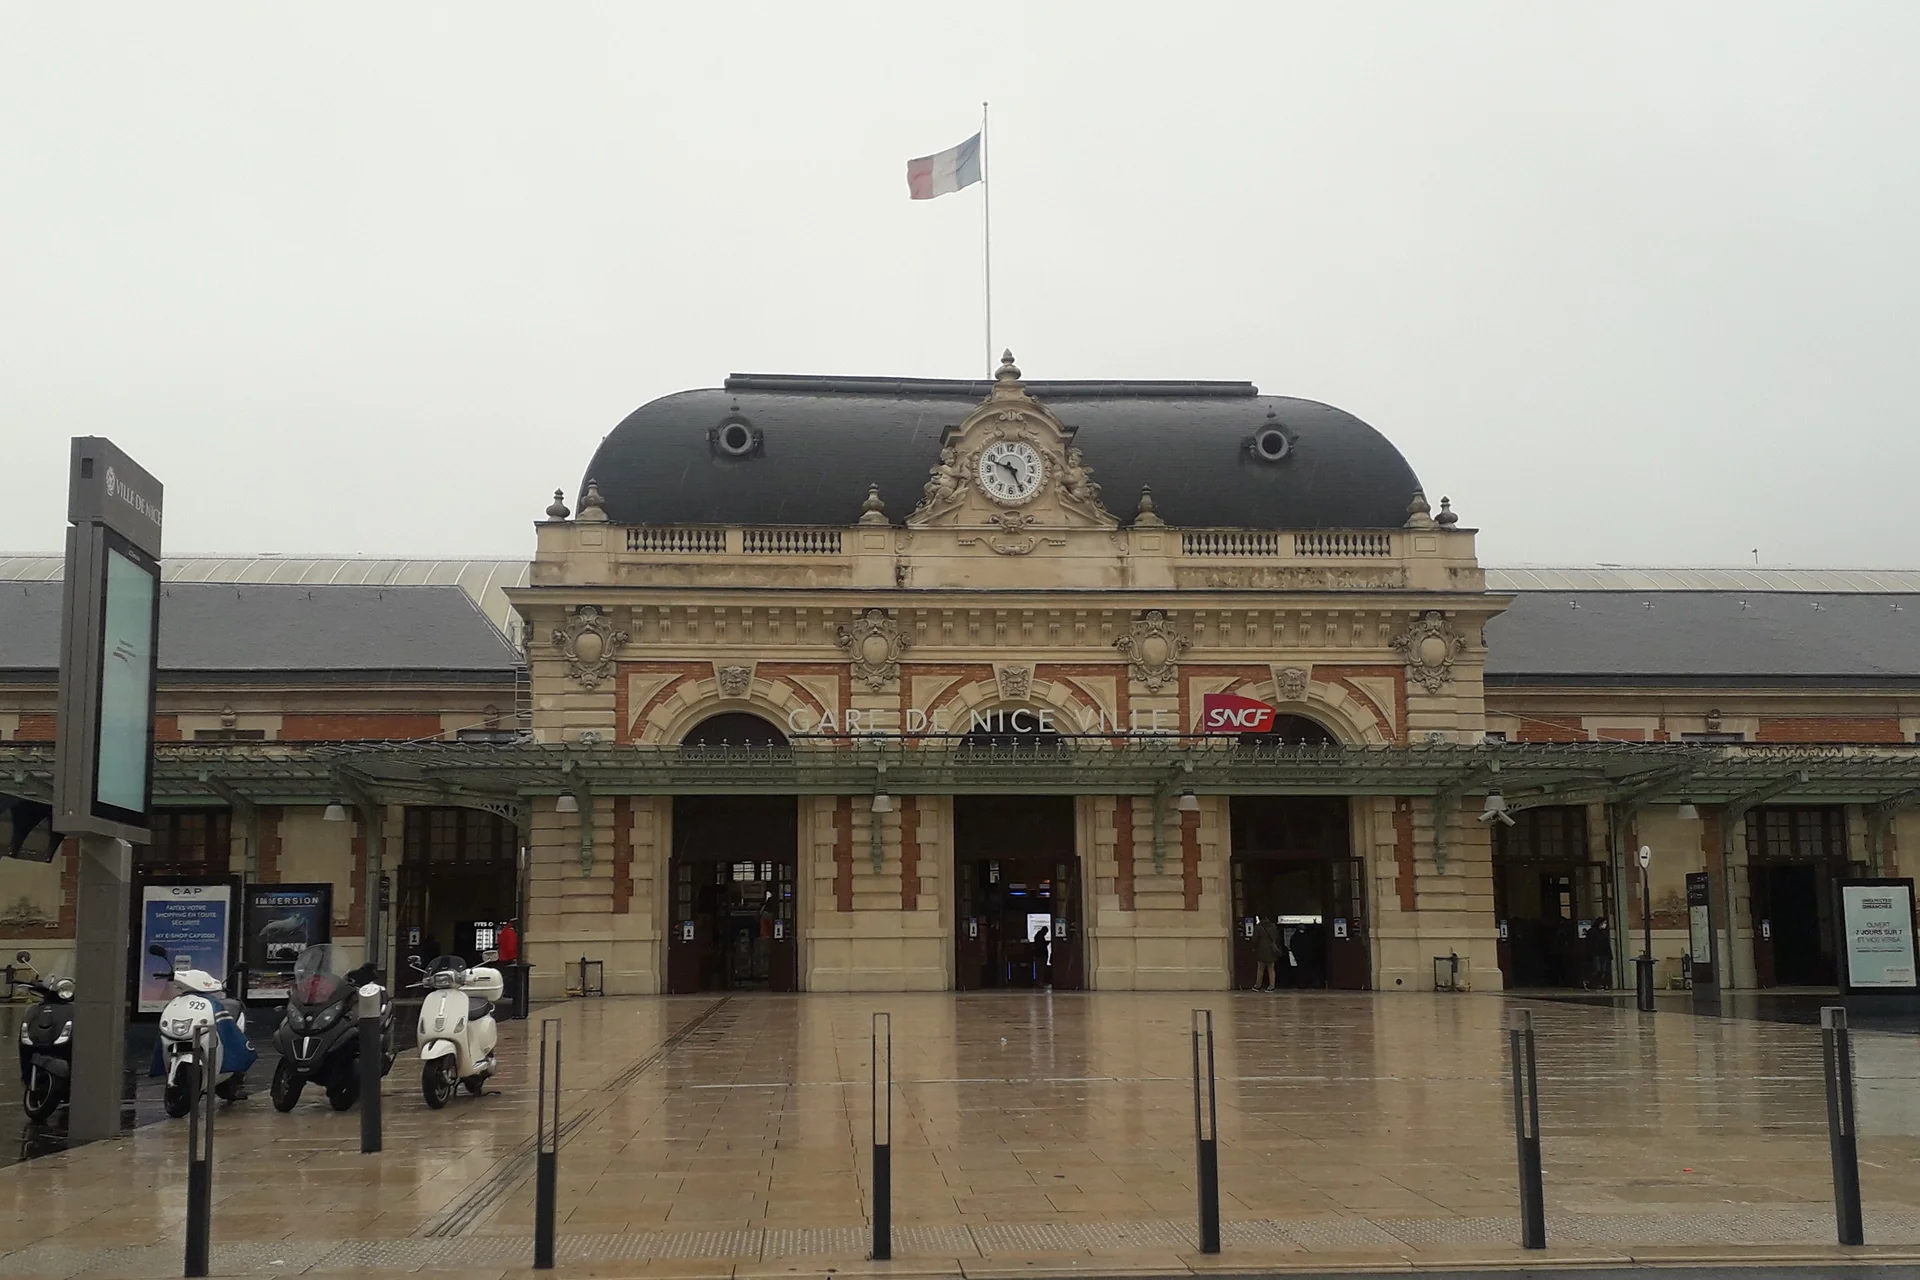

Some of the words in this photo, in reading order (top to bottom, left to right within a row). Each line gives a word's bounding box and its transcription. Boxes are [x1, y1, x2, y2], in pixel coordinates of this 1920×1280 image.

[1007, 444, 1014, 452] 12
[1027, 455, 1032, 463] 2
[986, 465, 992, 473] 9
[989, 475, 995, 483] 8
[1008, 487, 1014, 495] 6
[116, 479, 134, 506] VILLE
[135, 494, 145, 514] DE
[145, 502, 161, 527] NICE
[787, 709, 885, 733] GARE
[906, 709, 949, 733] DE
[970, 709, 1055, 733] NICE
[1074, 709, 1169, 734] VILLE
[1207, 708, 1271, 727] SNCF
[172, 887, 202, 895] CAP
[255, 897, 319, 905] IMMERSION
[189, 1000, 206, 1010] 929
